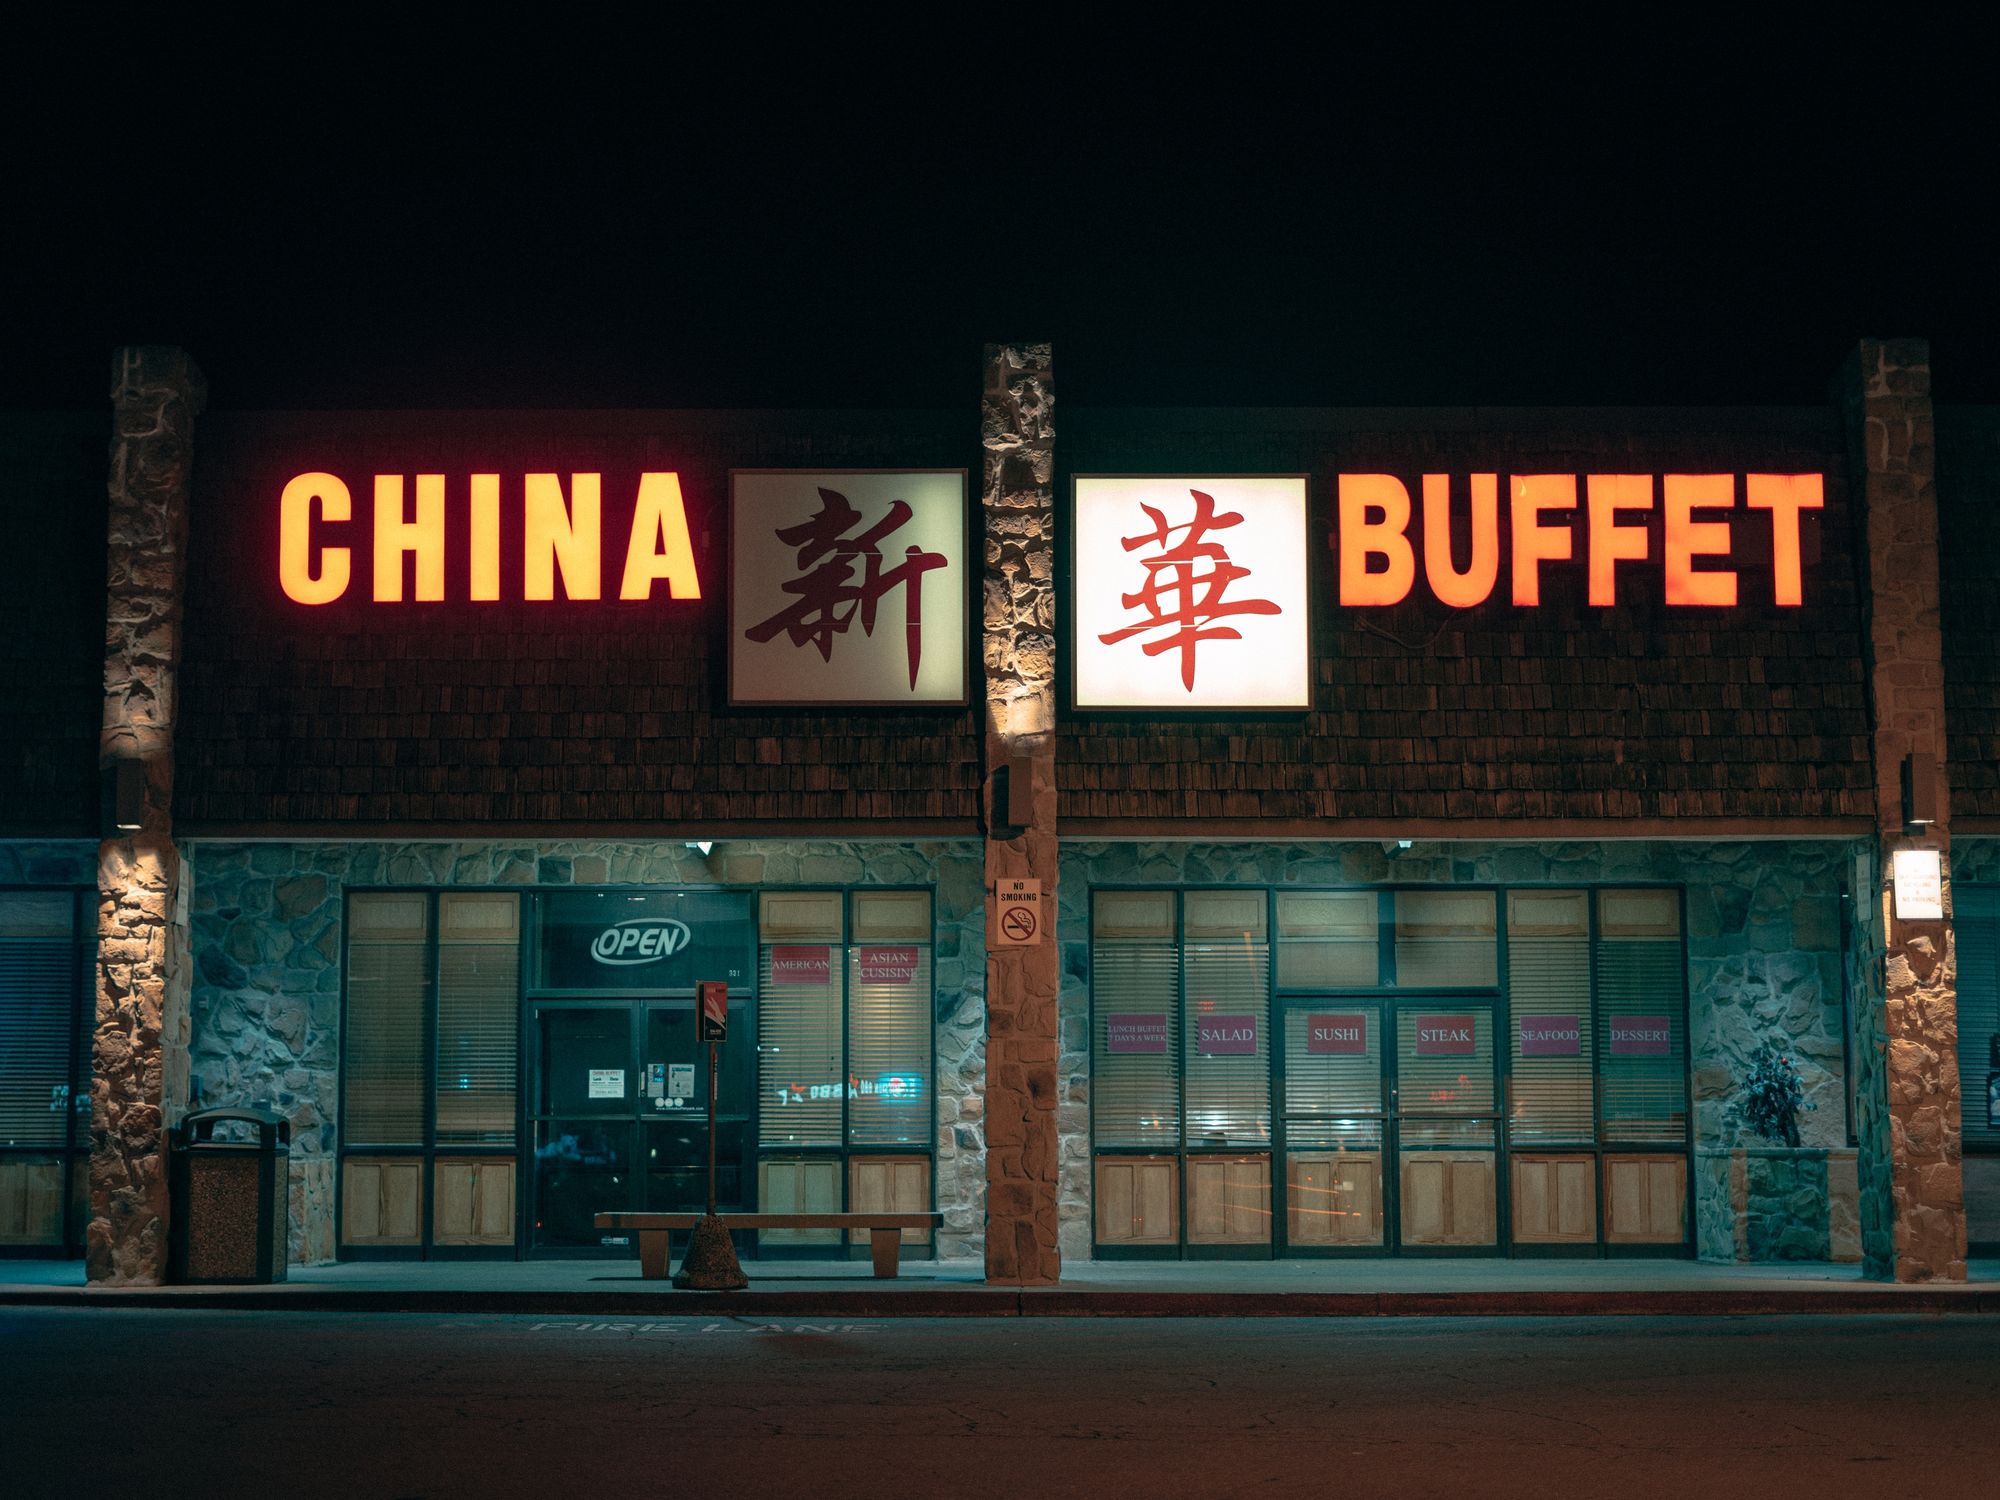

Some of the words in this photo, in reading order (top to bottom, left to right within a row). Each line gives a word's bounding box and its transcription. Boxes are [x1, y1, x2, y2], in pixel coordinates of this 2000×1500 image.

[279, 471, 702, 605] CHINA
[1338, 473, 1824, 608] BUFFET
[744, 486, 949, 692] 新
[1097, 488, 1283, 693] 華
[1013, 882, 1024, 890] NO
[1000, 892, 1037, 902] SMOKING
[598, 928, 680, 955] OPEN
[870, 953, 910, 963] ASIAN
[772, 959, 830, 970] AMERICAN
[1108, 1025, 1136, 1033] LUNCH
[1137, 1025, 1167, 1033] BUFFET
[1314, 1028, 1360, 1041] SUSHI
[1114, 1034, 1136, 1042] DAYS
[1143, 1034, 1166, 1042] WEEK
[1201, 1029, 1254, 1041] SALAD
[1420, 1029, 1471, 1042] STEAK
[1521, 1030, 1579, 1041] SEAFOOD
[1611, 1030, 1670, 1041] DESSERT
[529, 1322, 687, 1332] FIRE
[702, 1323, 888, 1333] LANE
